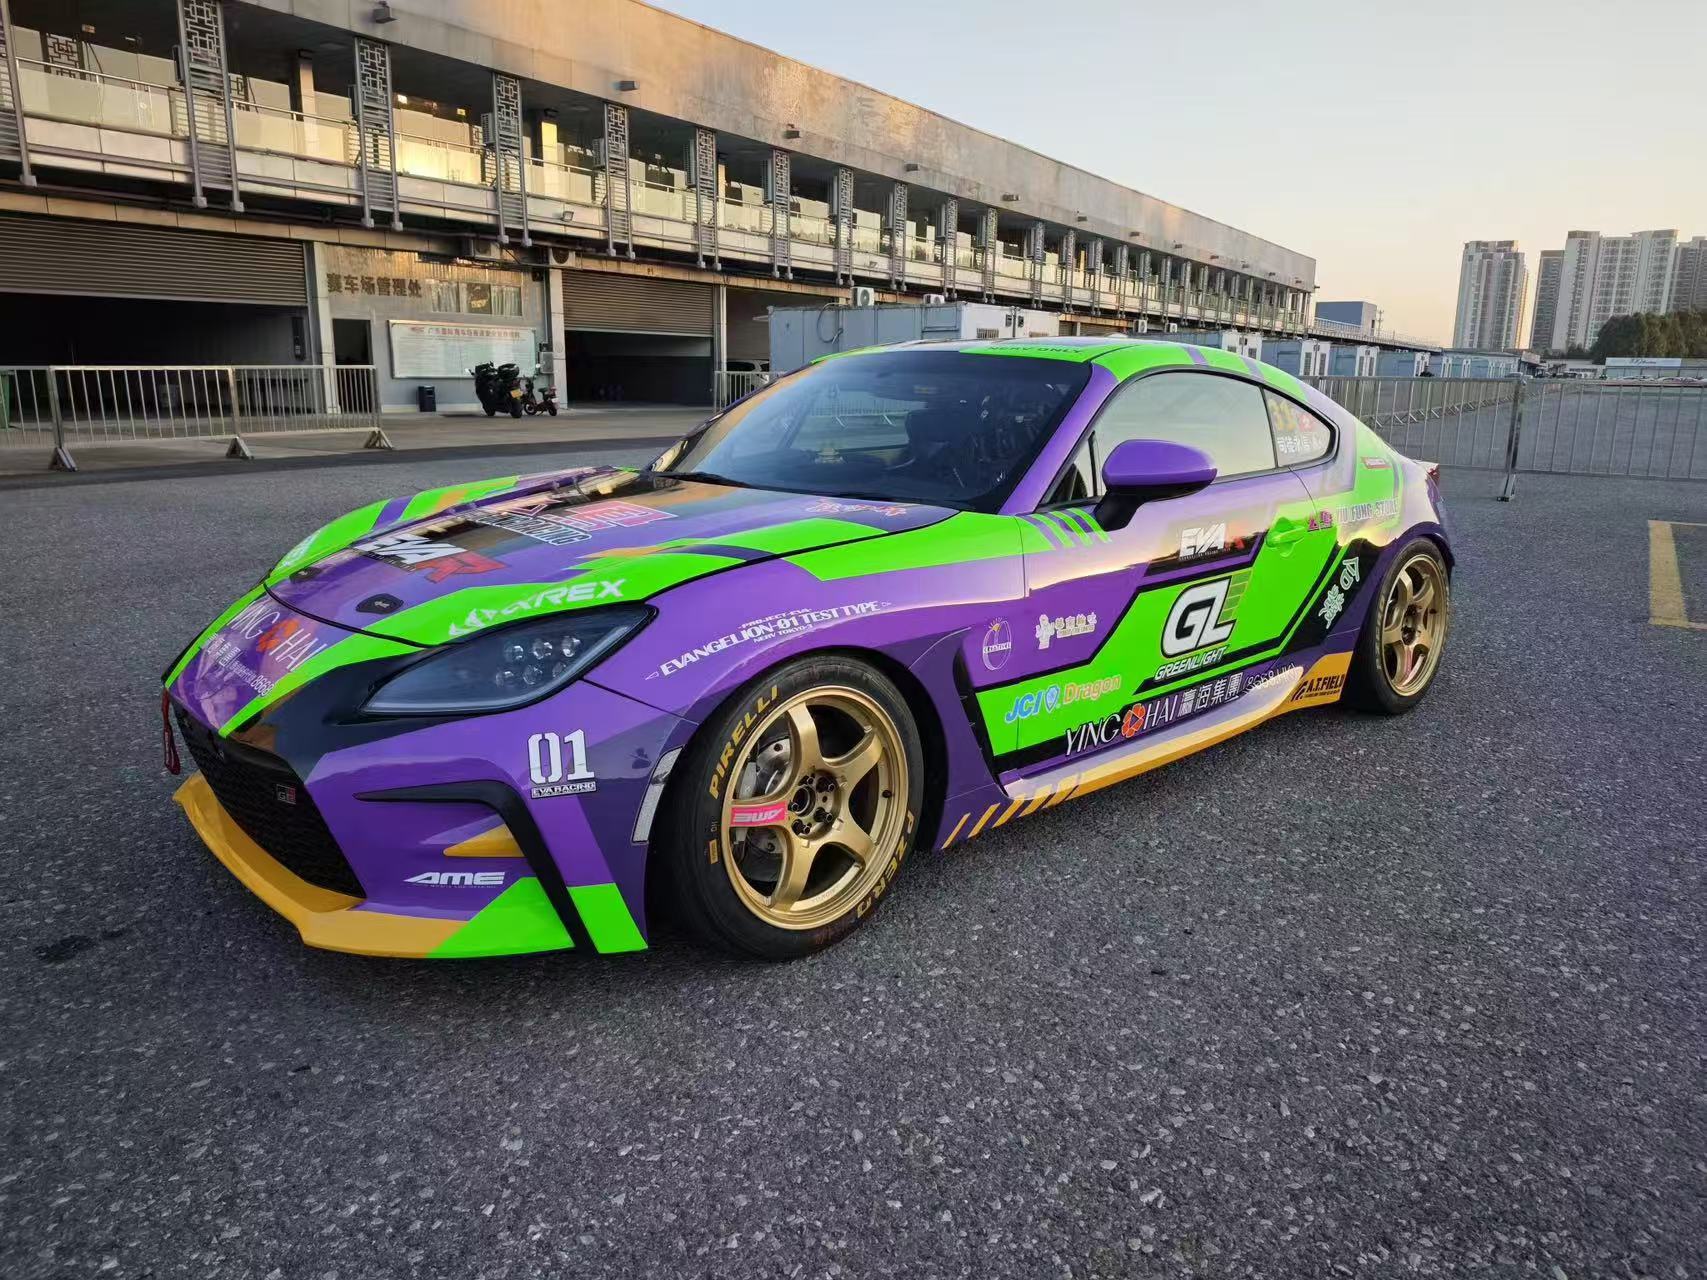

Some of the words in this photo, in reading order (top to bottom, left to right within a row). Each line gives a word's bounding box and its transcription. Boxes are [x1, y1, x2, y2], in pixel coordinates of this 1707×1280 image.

[1180, 522, 1226, 558] EVA
[659, 615, 799, 676] EVANGELION-01
[802, 608, 840, 626] TEST
[838, 600, 882, 617] TYPE
[1161, 575, 1236, 659] GL
[1154, 645, 1229, 681] GREENLIGHT
[1004, 697, 1042, 725] JCI
[1063, 674, 1122, 705] Dragon
[1064, 711, 1121, 758] YING
[1145, 694, 1178, 730] HAI
[527, 728, 595, 784] 01
[709, 684, 778, 800] PIRELLI
[403, 871, 506, 886] AME
